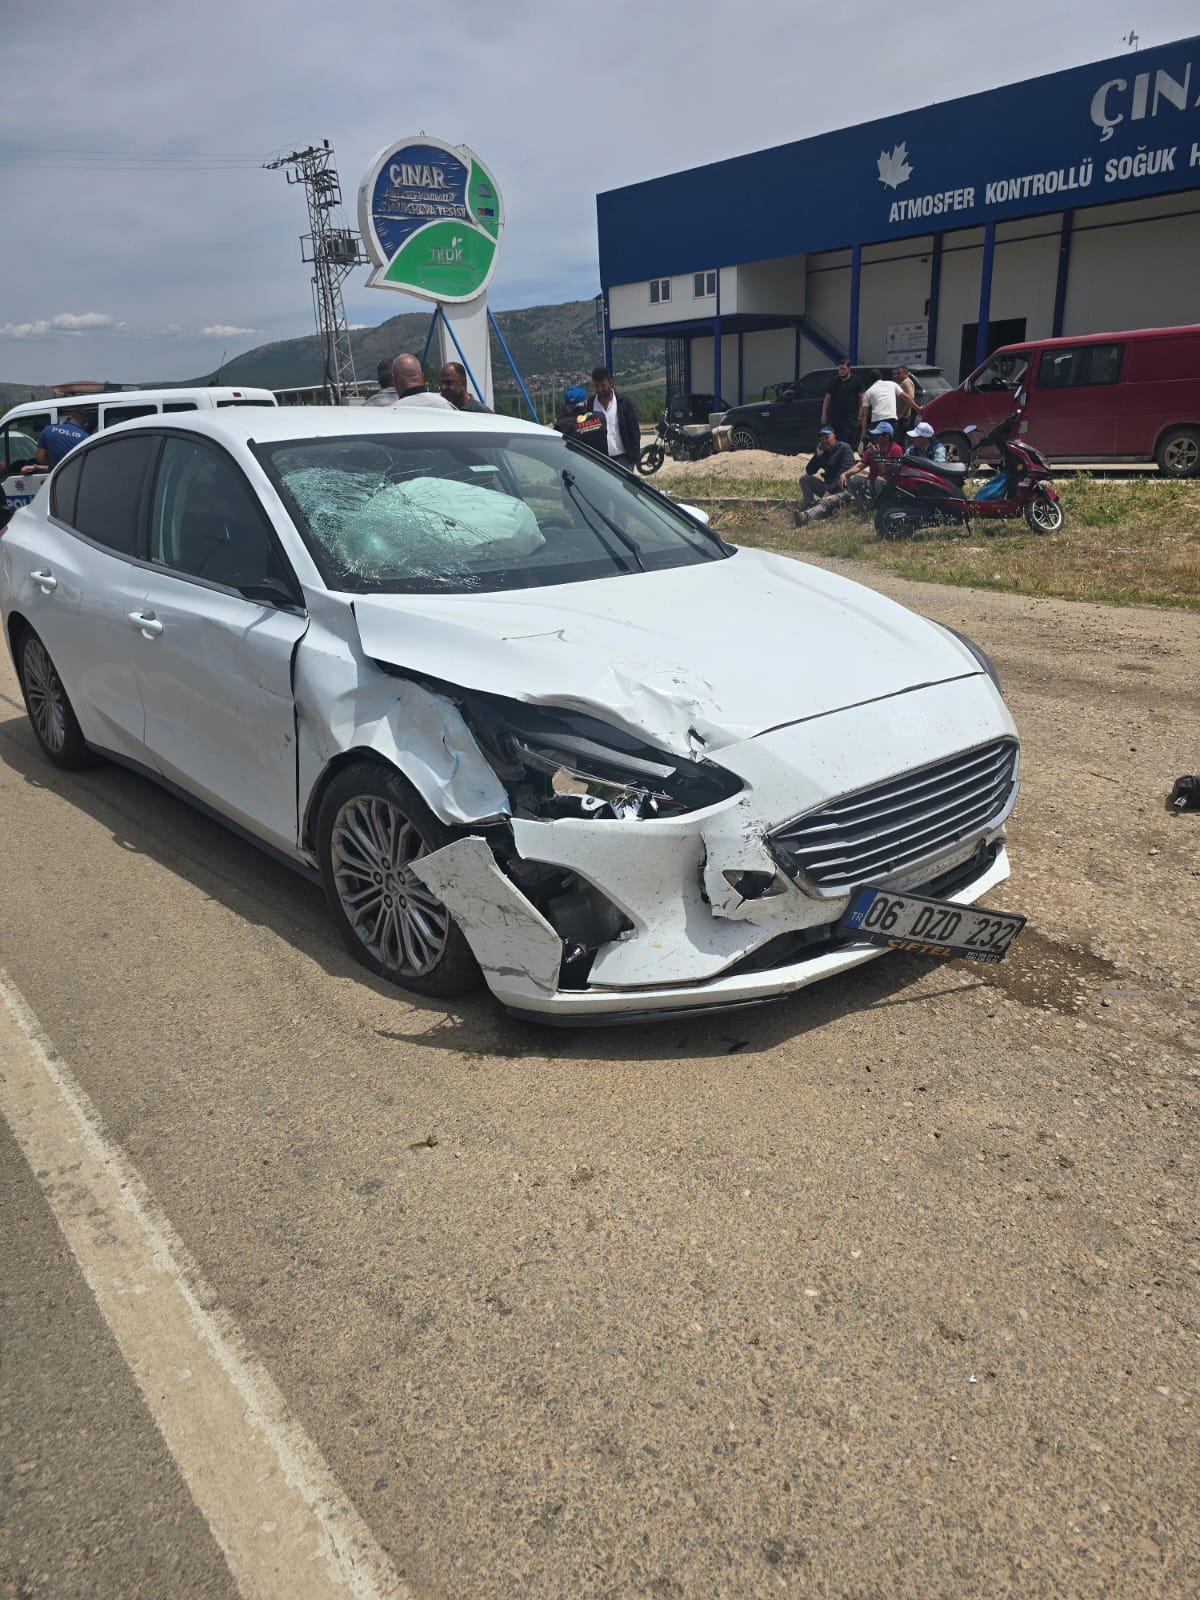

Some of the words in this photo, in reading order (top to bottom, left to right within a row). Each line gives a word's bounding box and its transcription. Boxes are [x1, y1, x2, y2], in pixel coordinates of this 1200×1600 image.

[1090, 61, 1200, 143] ÇIN
[389, 163, 446, 190] ÇINAR
[889, 187, 975, 223] ATMOSFER
[985, 157, 1093, 204] KONTROLLÜ
[1105, 145, 1177, 183] SOĞUK
[851, 911, 864, 923] TR
[865, 897, 904, 930] 06
[909, 906, 961, 941] DZD
[964, 918, 1015, 949] 232
